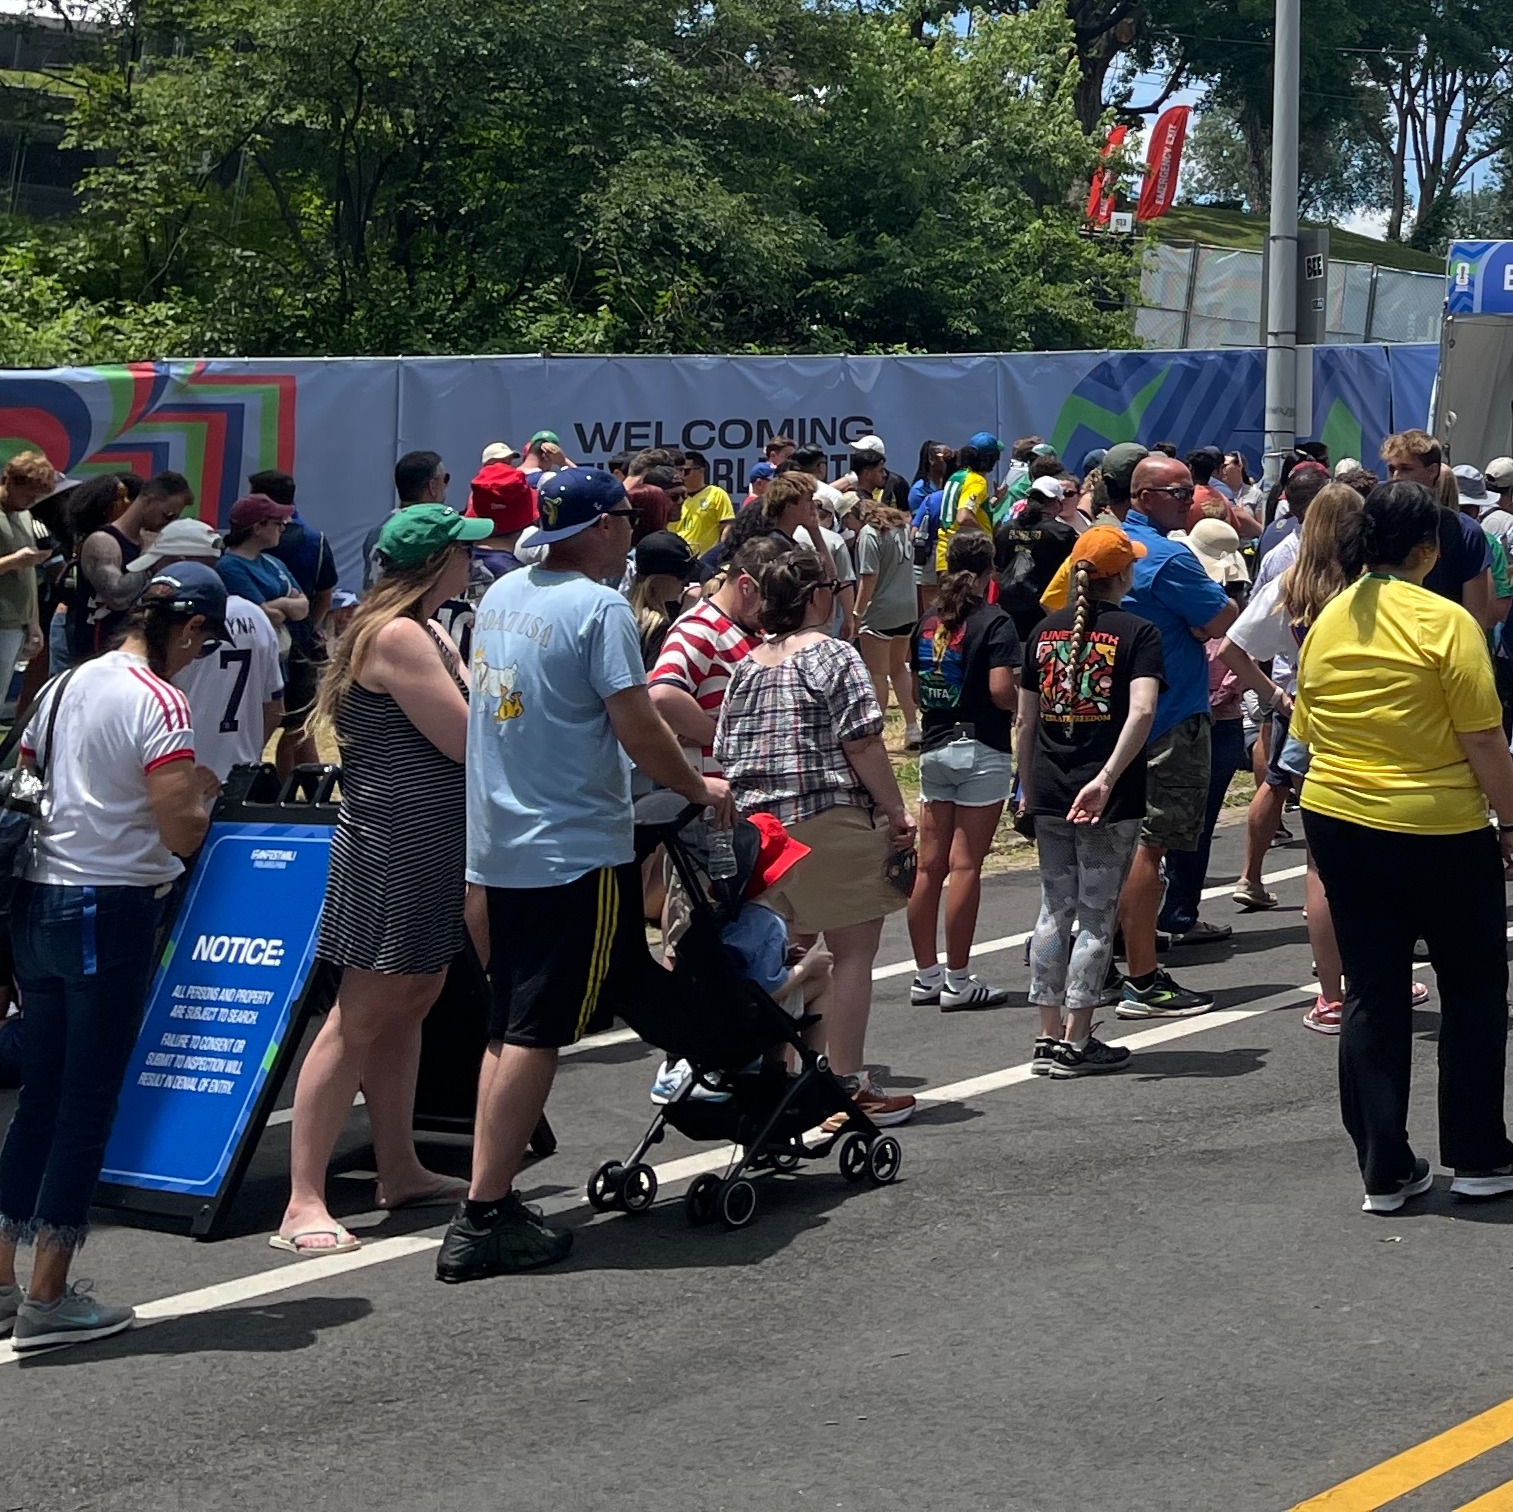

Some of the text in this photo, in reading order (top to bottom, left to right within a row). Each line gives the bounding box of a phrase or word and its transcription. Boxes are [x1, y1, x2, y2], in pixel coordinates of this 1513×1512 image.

[1155, 146, 1173, 205] EMERGENCY
[1307, 255, 1322, 278] BEE
[573, 416, 874, 453] WELCOMING
[220, 649, 252, 733] 7
[928, 688, 950, 700] FIFA
[192, 935, 285, 967] NOTICE:
